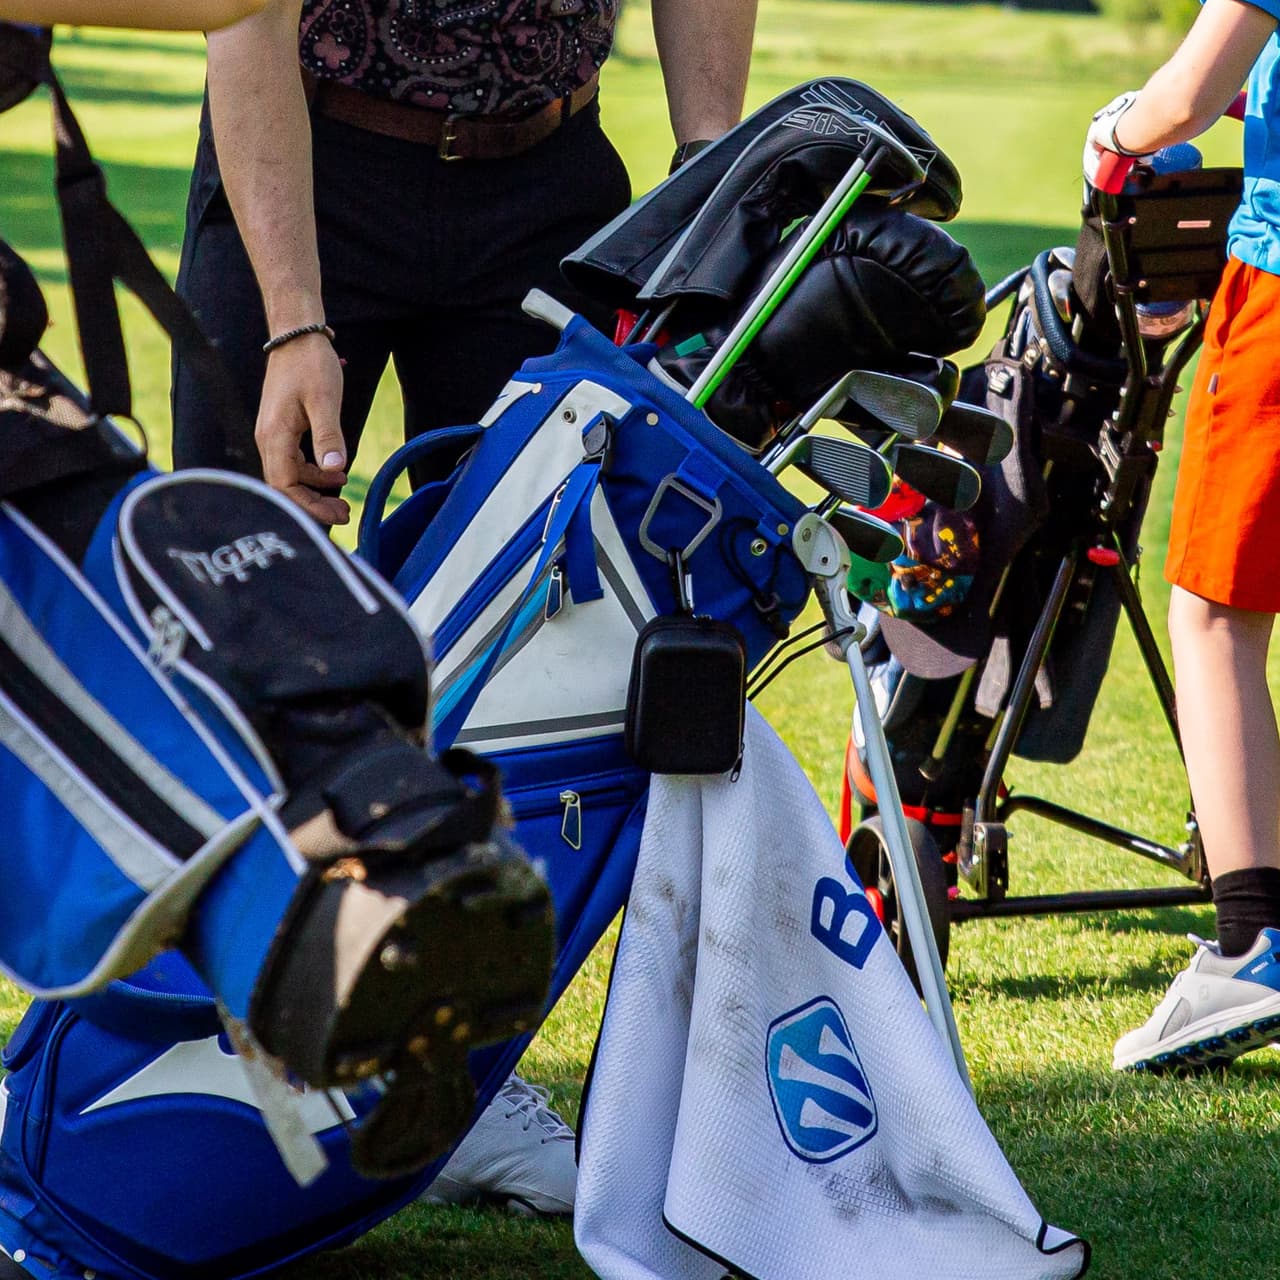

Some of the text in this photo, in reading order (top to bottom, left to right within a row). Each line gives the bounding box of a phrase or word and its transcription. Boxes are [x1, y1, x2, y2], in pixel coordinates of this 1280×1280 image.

[782, 109, 871, 145] SIM
[167, 531, 297, 587] TIGER
[810, 850, 883, 970] B
